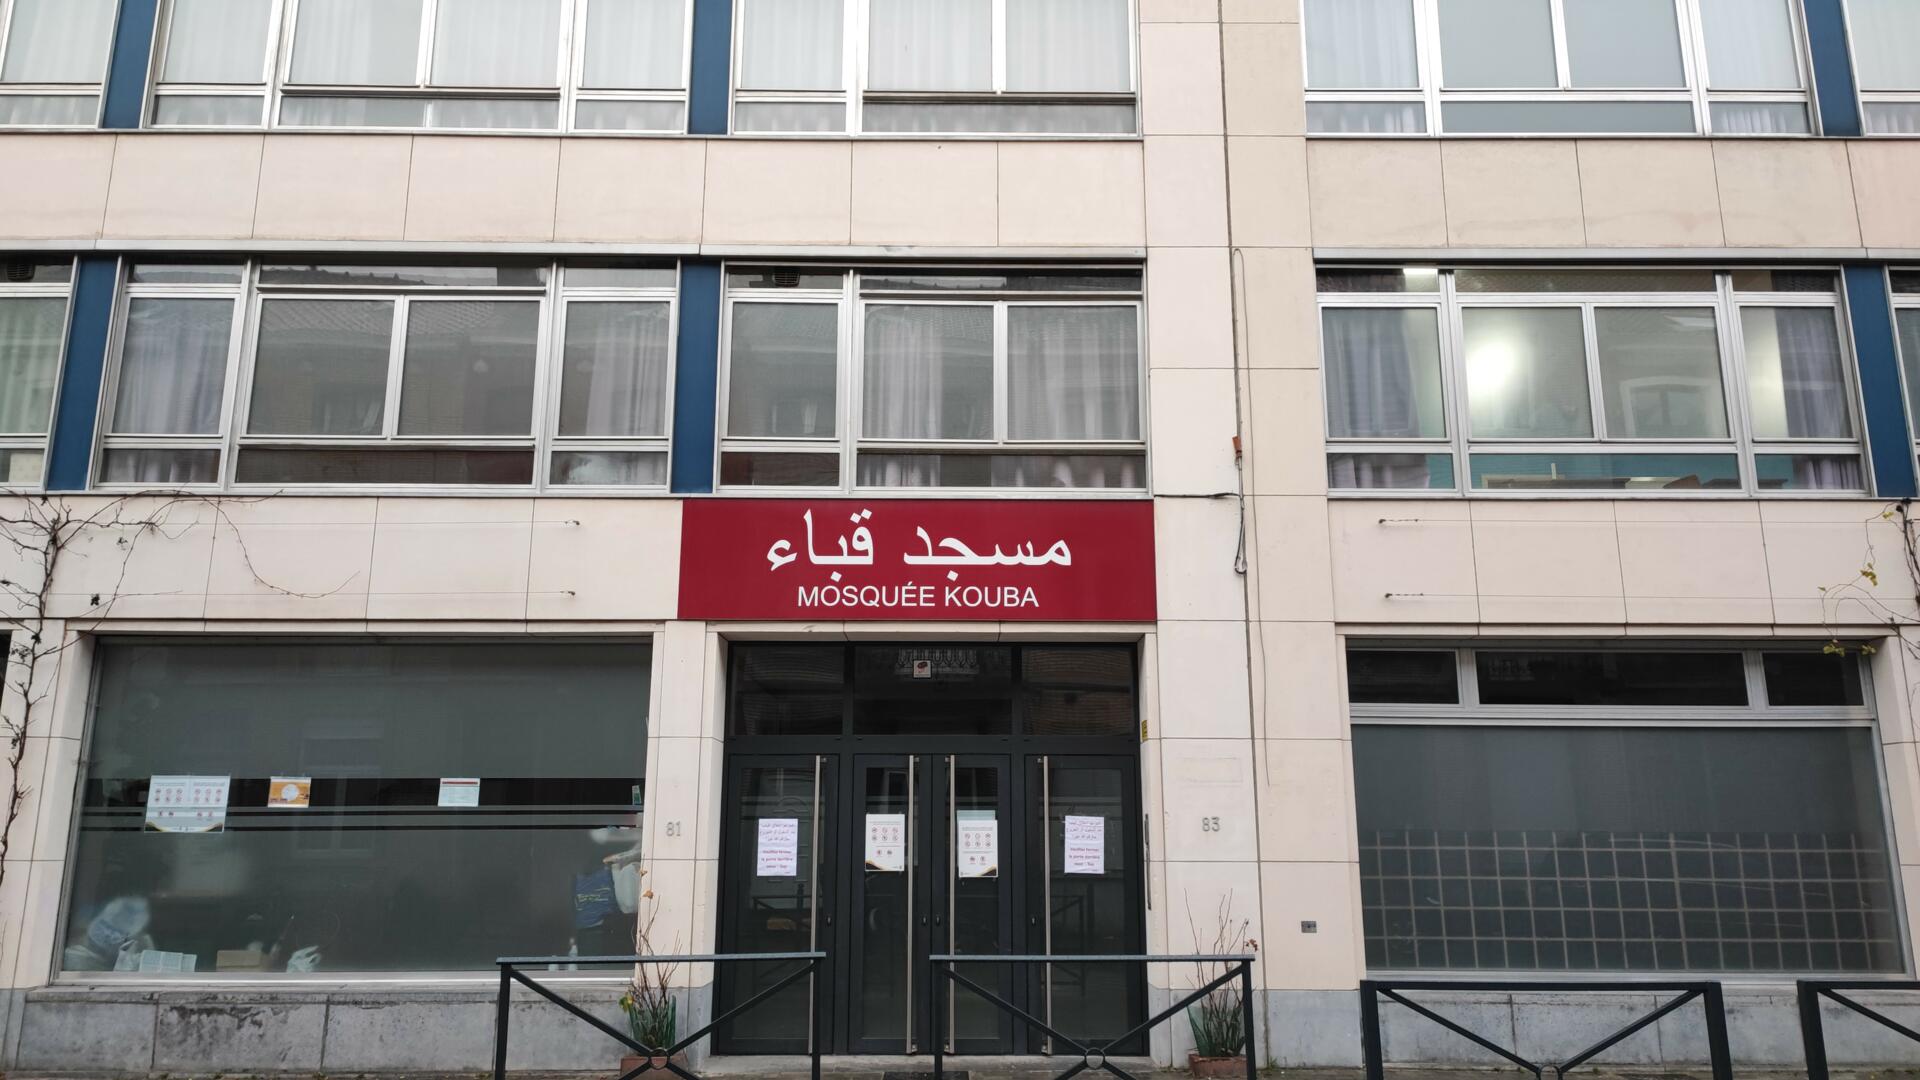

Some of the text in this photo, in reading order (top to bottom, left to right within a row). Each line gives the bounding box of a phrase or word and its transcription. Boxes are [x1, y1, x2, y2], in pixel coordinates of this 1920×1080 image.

[766, 508, 1072, 583] مسجد قباء
[797, 581, 1040, 608] MOSQUÉE KOUBA
[665, 820, 682, 837] 81
[1202, 816, 1220, 832] 83
